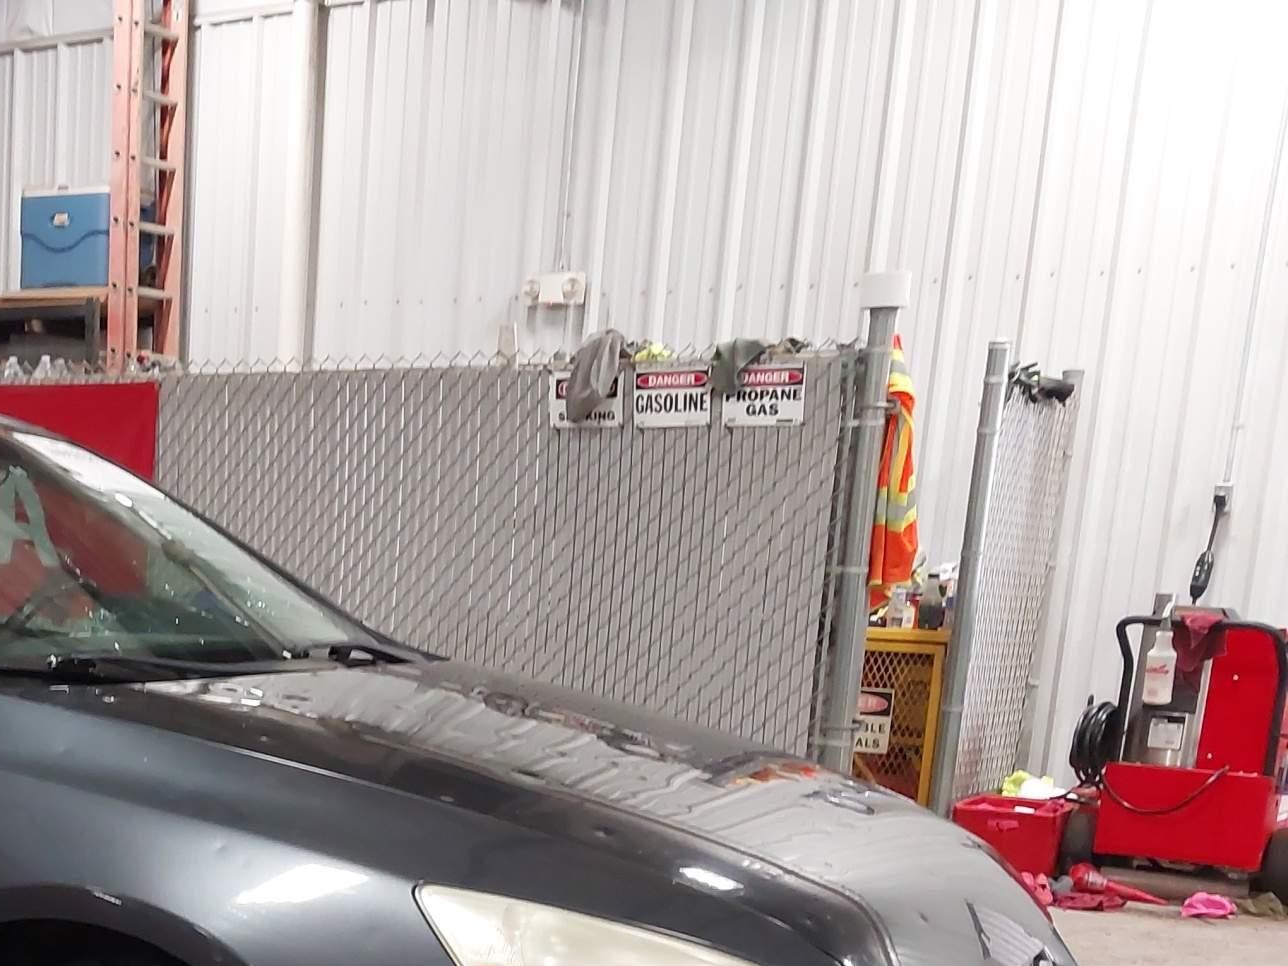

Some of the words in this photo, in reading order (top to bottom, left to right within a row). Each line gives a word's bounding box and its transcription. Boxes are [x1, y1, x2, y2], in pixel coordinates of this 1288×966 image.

[648, 373, 696, 387] DANGER
[635, 391, 708, 414] GASOLINE
[745, 404, 779, 416] GAS
